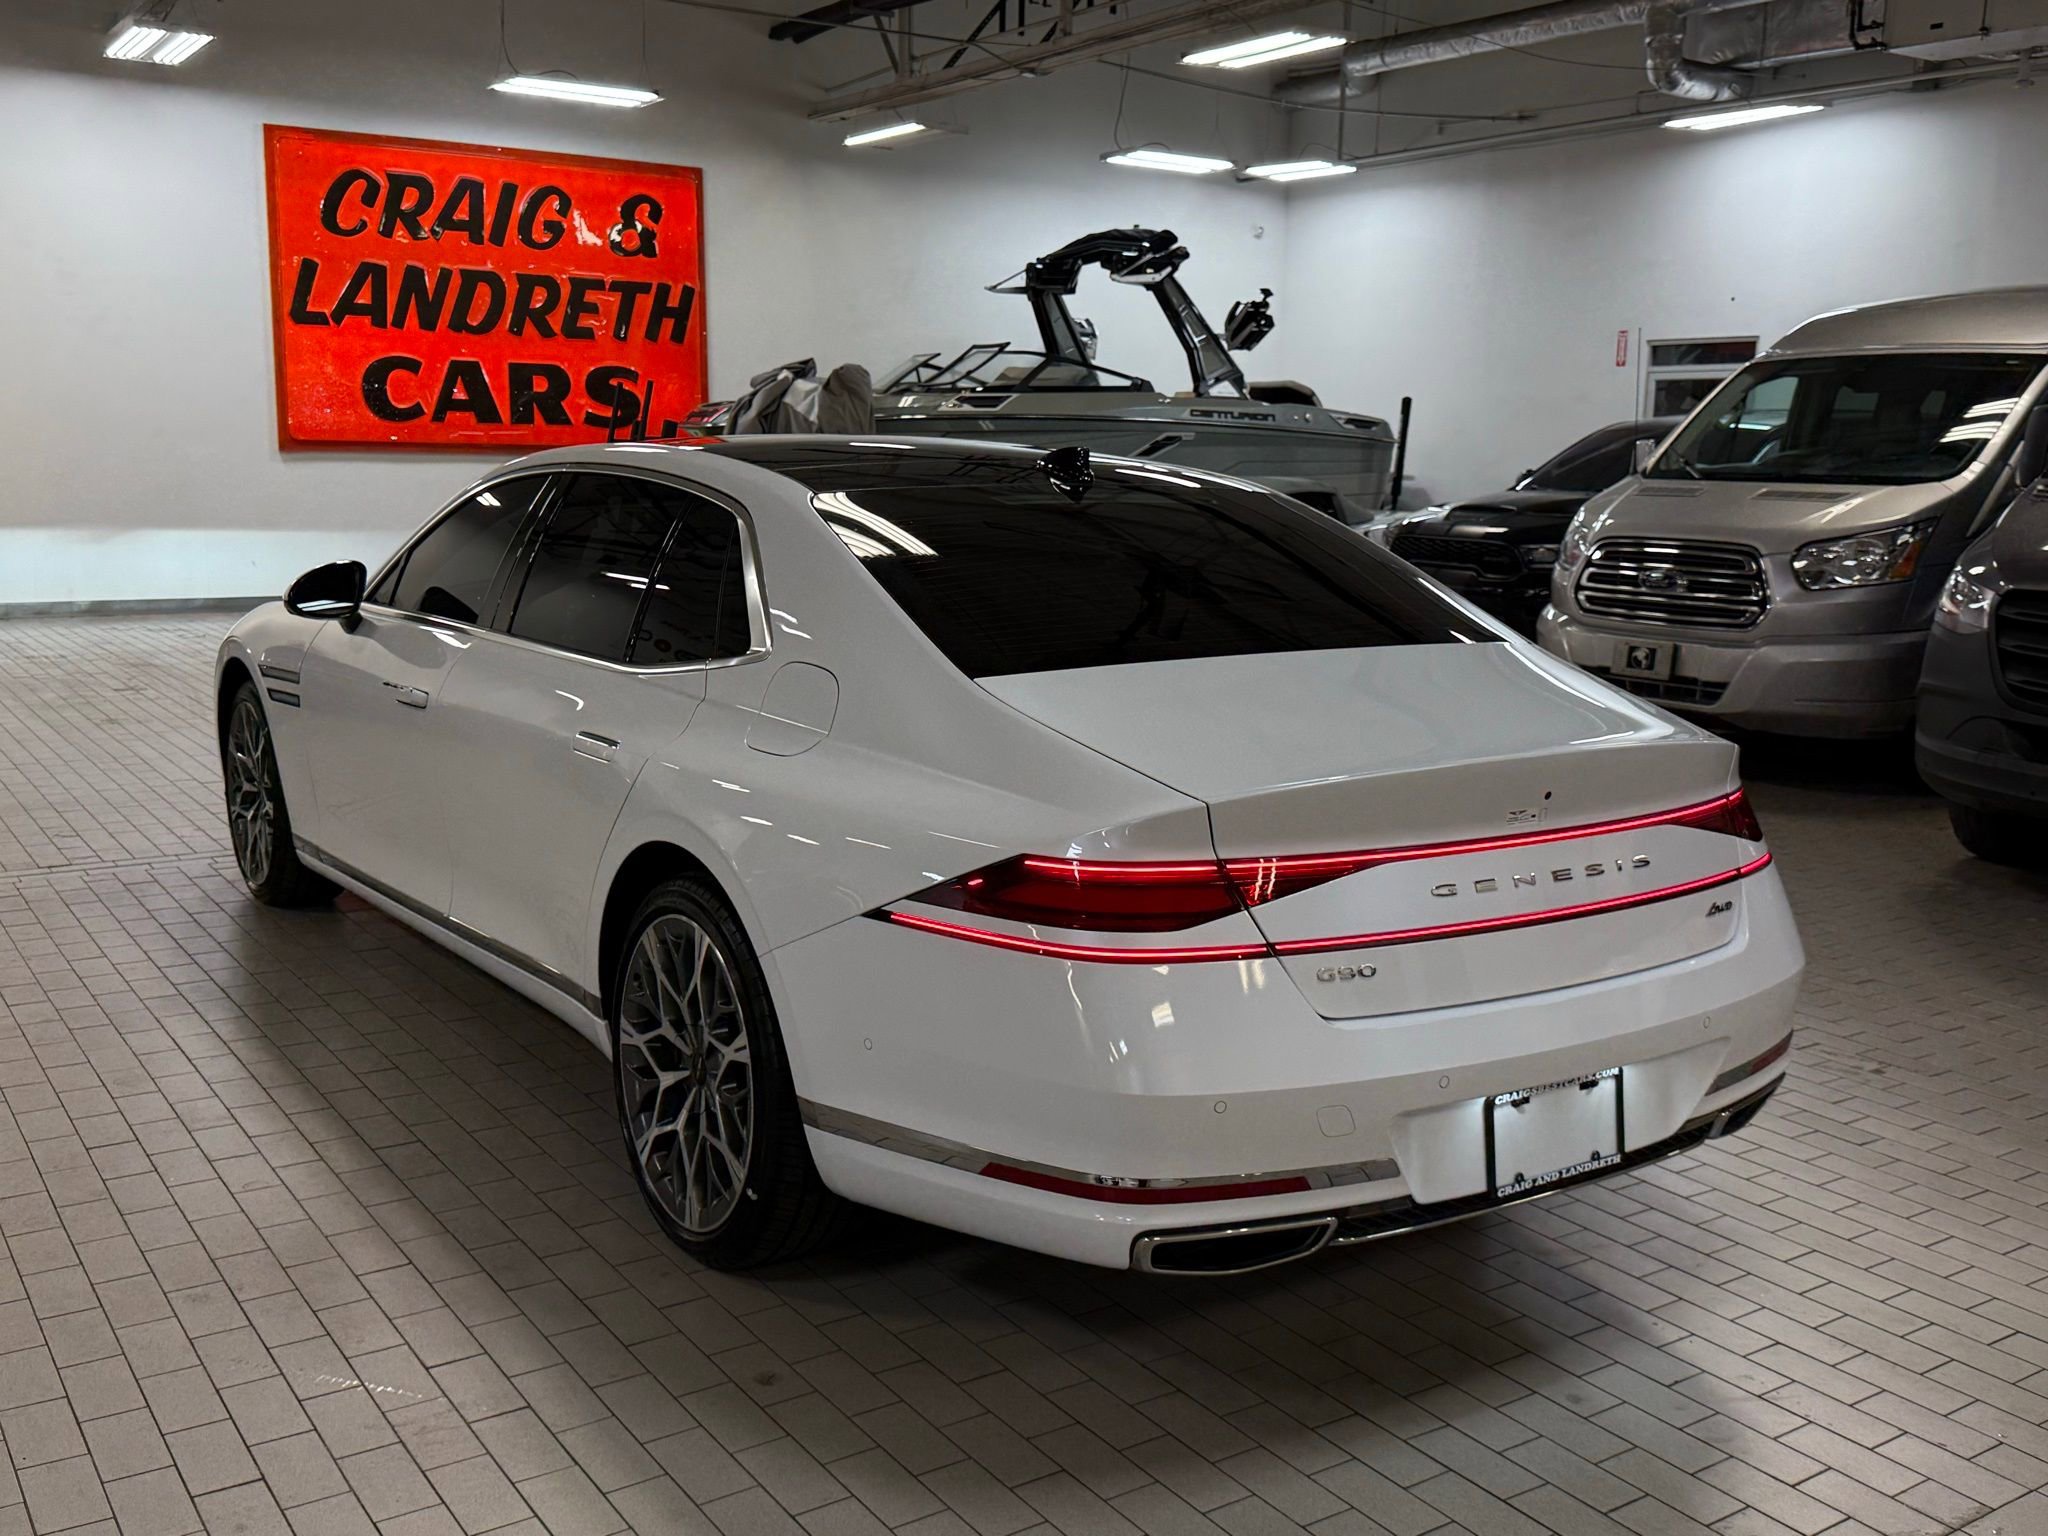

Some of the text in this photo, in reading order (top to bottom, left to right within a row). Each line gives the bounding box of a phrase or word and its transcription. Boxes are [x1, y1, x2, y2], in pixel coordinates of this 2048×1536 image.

[320, 168, 663, 258] CRAIG &
[289, 257, 696, 344] LANDRETH
[361, 355, 643, 429] CARS
[1431, 854, 1651, 897] GENESIS
[1497, 1154, 1621, 1198] CRAIG AND LANDRETH
